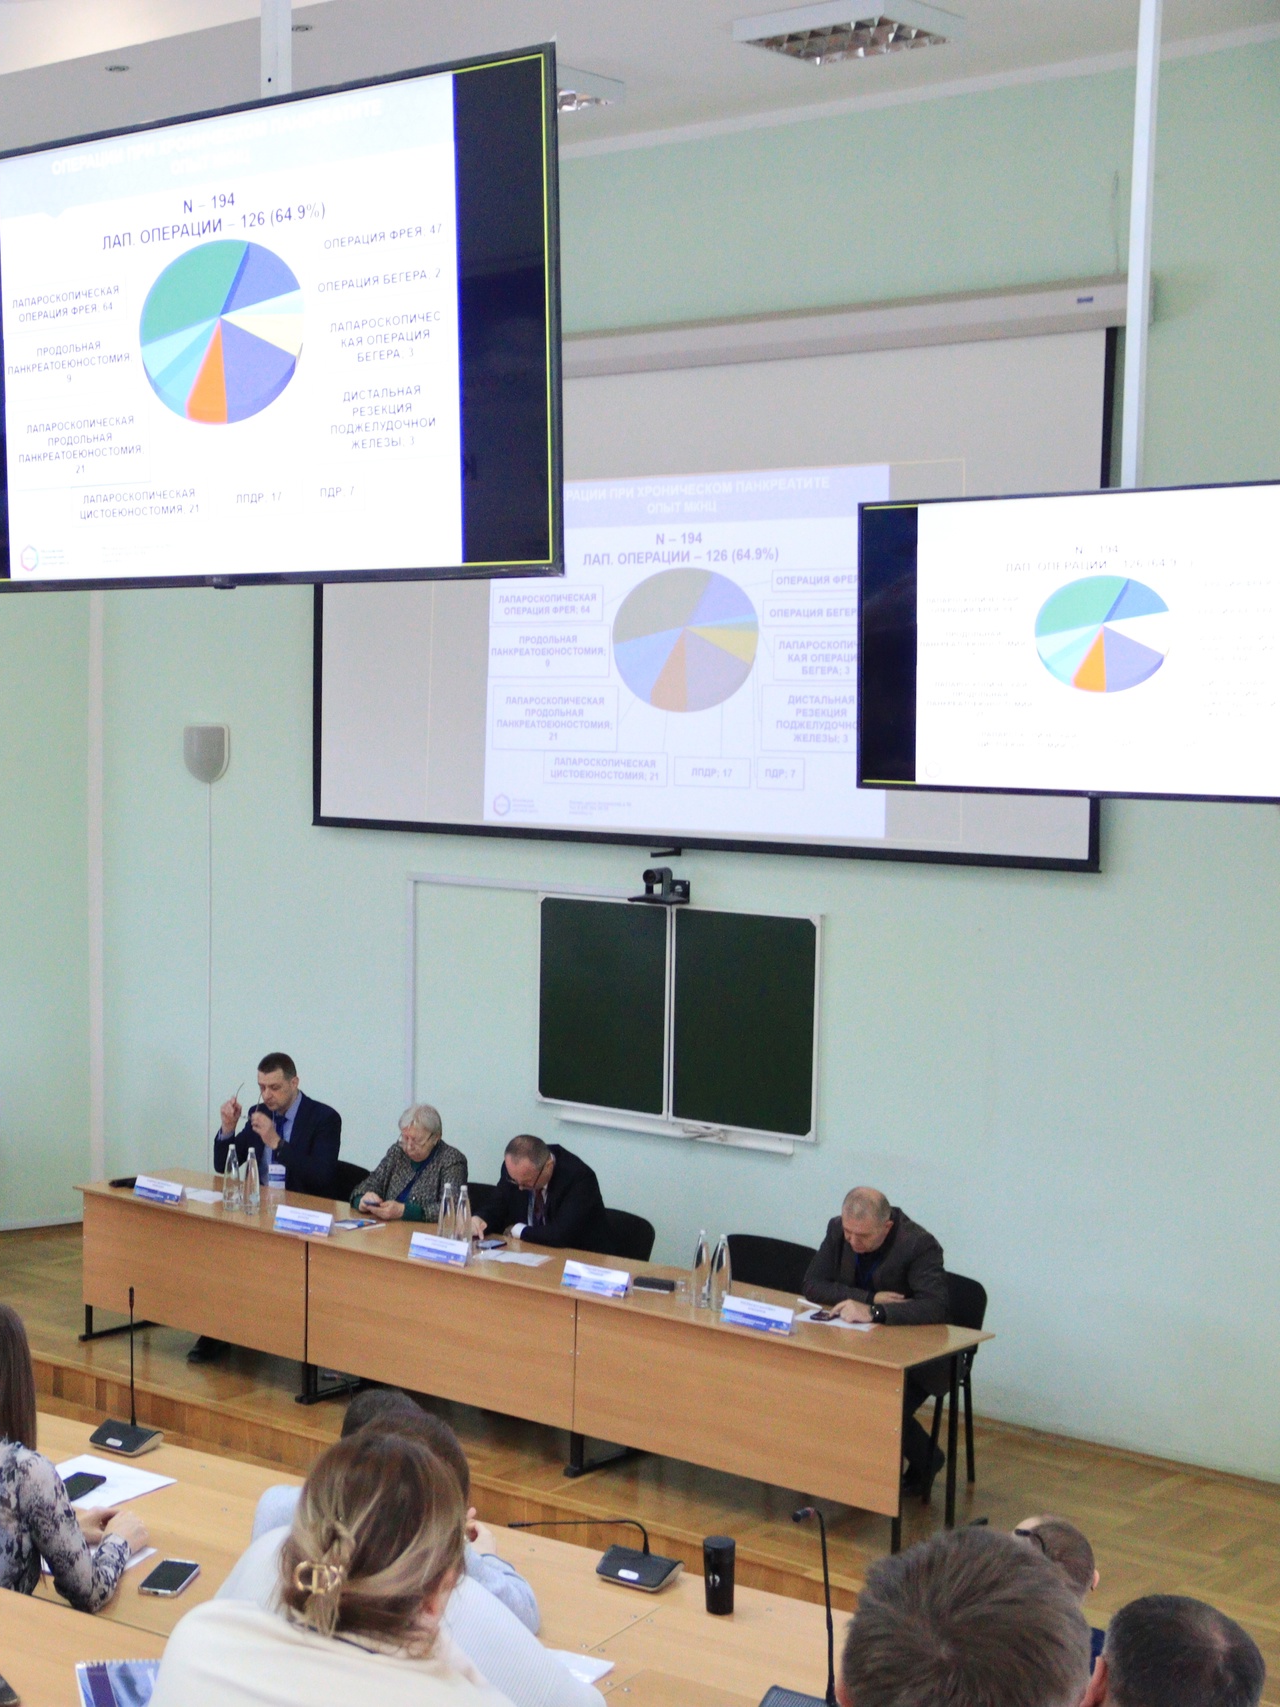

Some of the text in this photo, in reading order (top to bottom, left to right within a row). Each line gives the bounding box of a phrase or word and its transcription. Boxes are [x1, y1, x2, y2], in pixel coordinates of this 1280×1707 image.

[183, 200, 193, 214] N
[211, 192, 235, 209] 194
[102, 231, 136, 250] ЛАП.
[140, 218, 222, 245] ОПЕРАЦИИ
[240, 210, 265, 229] 126
[270, 201, 326, 226] (64.9%)
[324, 231, 386, 249] ОПЕРАЦИЯ
[430, 223, 442, 234] 47
[318, 275, 380, 293] ОПЕРАЦИЯ
[12, 285, 120, 309] ЛАПАРОСКОПИЧЕСКАЯ
[18, 307, 69, 323] ОПЕРАЦИЯ
[103, 301, 113, 311] 64
[330, 311, 441, 333] ЛАПАРОСКОПИЧЕС
[341, 329, 430, 349] КАЯ ОПЕРАЦИЯ
[37, 340, 101, 357] ПРОДОЛЬНАЯ
[343, 384, 421, 403] ДИСТАЛЬНАЯ
[352, 402, 412, 417] РЕЗЕКЦИЯ
[26, 415, 134, 434] ЛАПАРОСКОПИЧЕСКАЯ
[47, 432, 112, 447] ПРОДОЛЬНАЯ
[75, 464, 85, 474] 21
[564, 475, 830, 503] РАЦИИ ПРИ ХРОНИЧЕСКОМ ПАНКРЕАТИТЕ
[83, 488, 195, 504] ЛАПАРОСКОПИЧЕСКАЯ
[189, 503, 199, 514] 21
[647, 500, 717, 515] ОПЫТ МКНЦ
[656, 533, 665, 545] N
[680, 532, 703, 545] 194
[583, 553, 614, 566] ЛАП.
[617, 549, 690, 566] ОПЕРАЦИИ
[706, 549, 728, 562] 126
[731, 547, 779, 564] (64.9%)
[776, 575, 830, 587] ОПЕРАЦИЯ
[497, 593, 597, 604] ЛАПАРОСКОПИЧЕСКАЯ
[504, 606, 550, 616] ОПЕРАЦИЯ
[580, 604, 590, 614] 64
[769, 607, 858, 619] ОПЕРАЦИЯ БЕГЕР
[519, 634, 578, 646] ПРОДОЛЬНАЯ
[787, 652, 858, 664] КАЯ ОПЕРАЦИ
[844, 666, 850, 675] 3
[505, 696, 605, 706] ЛАПАРОСКОПИЧЕСКАЯ
[787, 694, 856, 706] ДИСТАЛЬНАЯ
[524, 708, 584, 718] ПРОДОЛЬНАЯ
[795, 708, 847, 719] РЕЗЕКЦИЯ
[775, 719, 858, 731] ПОДЖЕЛУДОЧНО
[548, 732, 558, 741] 21
[842, 734, 849, 743] 3
[554, 757, 656, 769] ЛАПАРОСКОПИЧЕСКАЯ
[649, 772, 659, 781] 21
[723, 768, 733, 777] 17
[790, 769, 796, 777] 7
